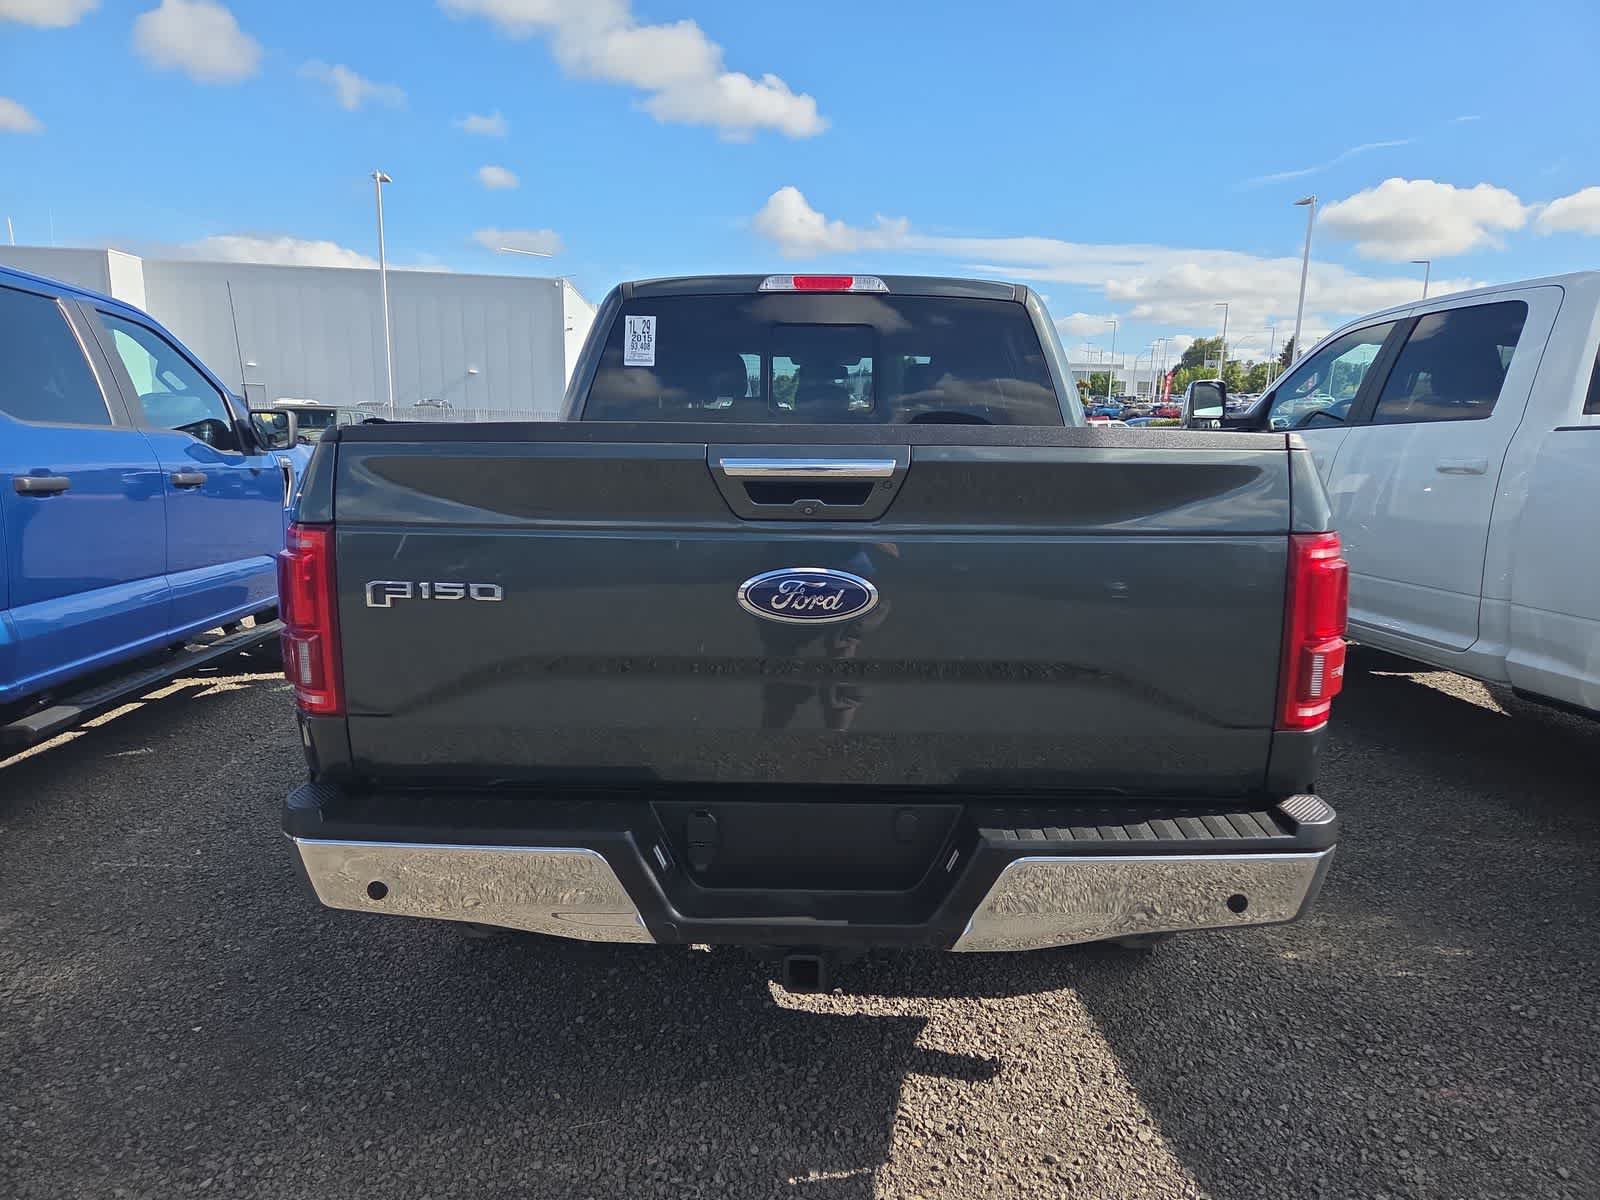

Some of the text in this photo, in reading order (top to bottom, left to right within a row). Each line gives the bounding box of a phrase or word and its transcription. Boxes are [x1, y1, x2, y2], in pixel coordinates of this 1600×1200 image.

[642, 319, 651, 334] 29
[632, 334, 653, 342] 2015
[771, 579, 845, 610] Ford
